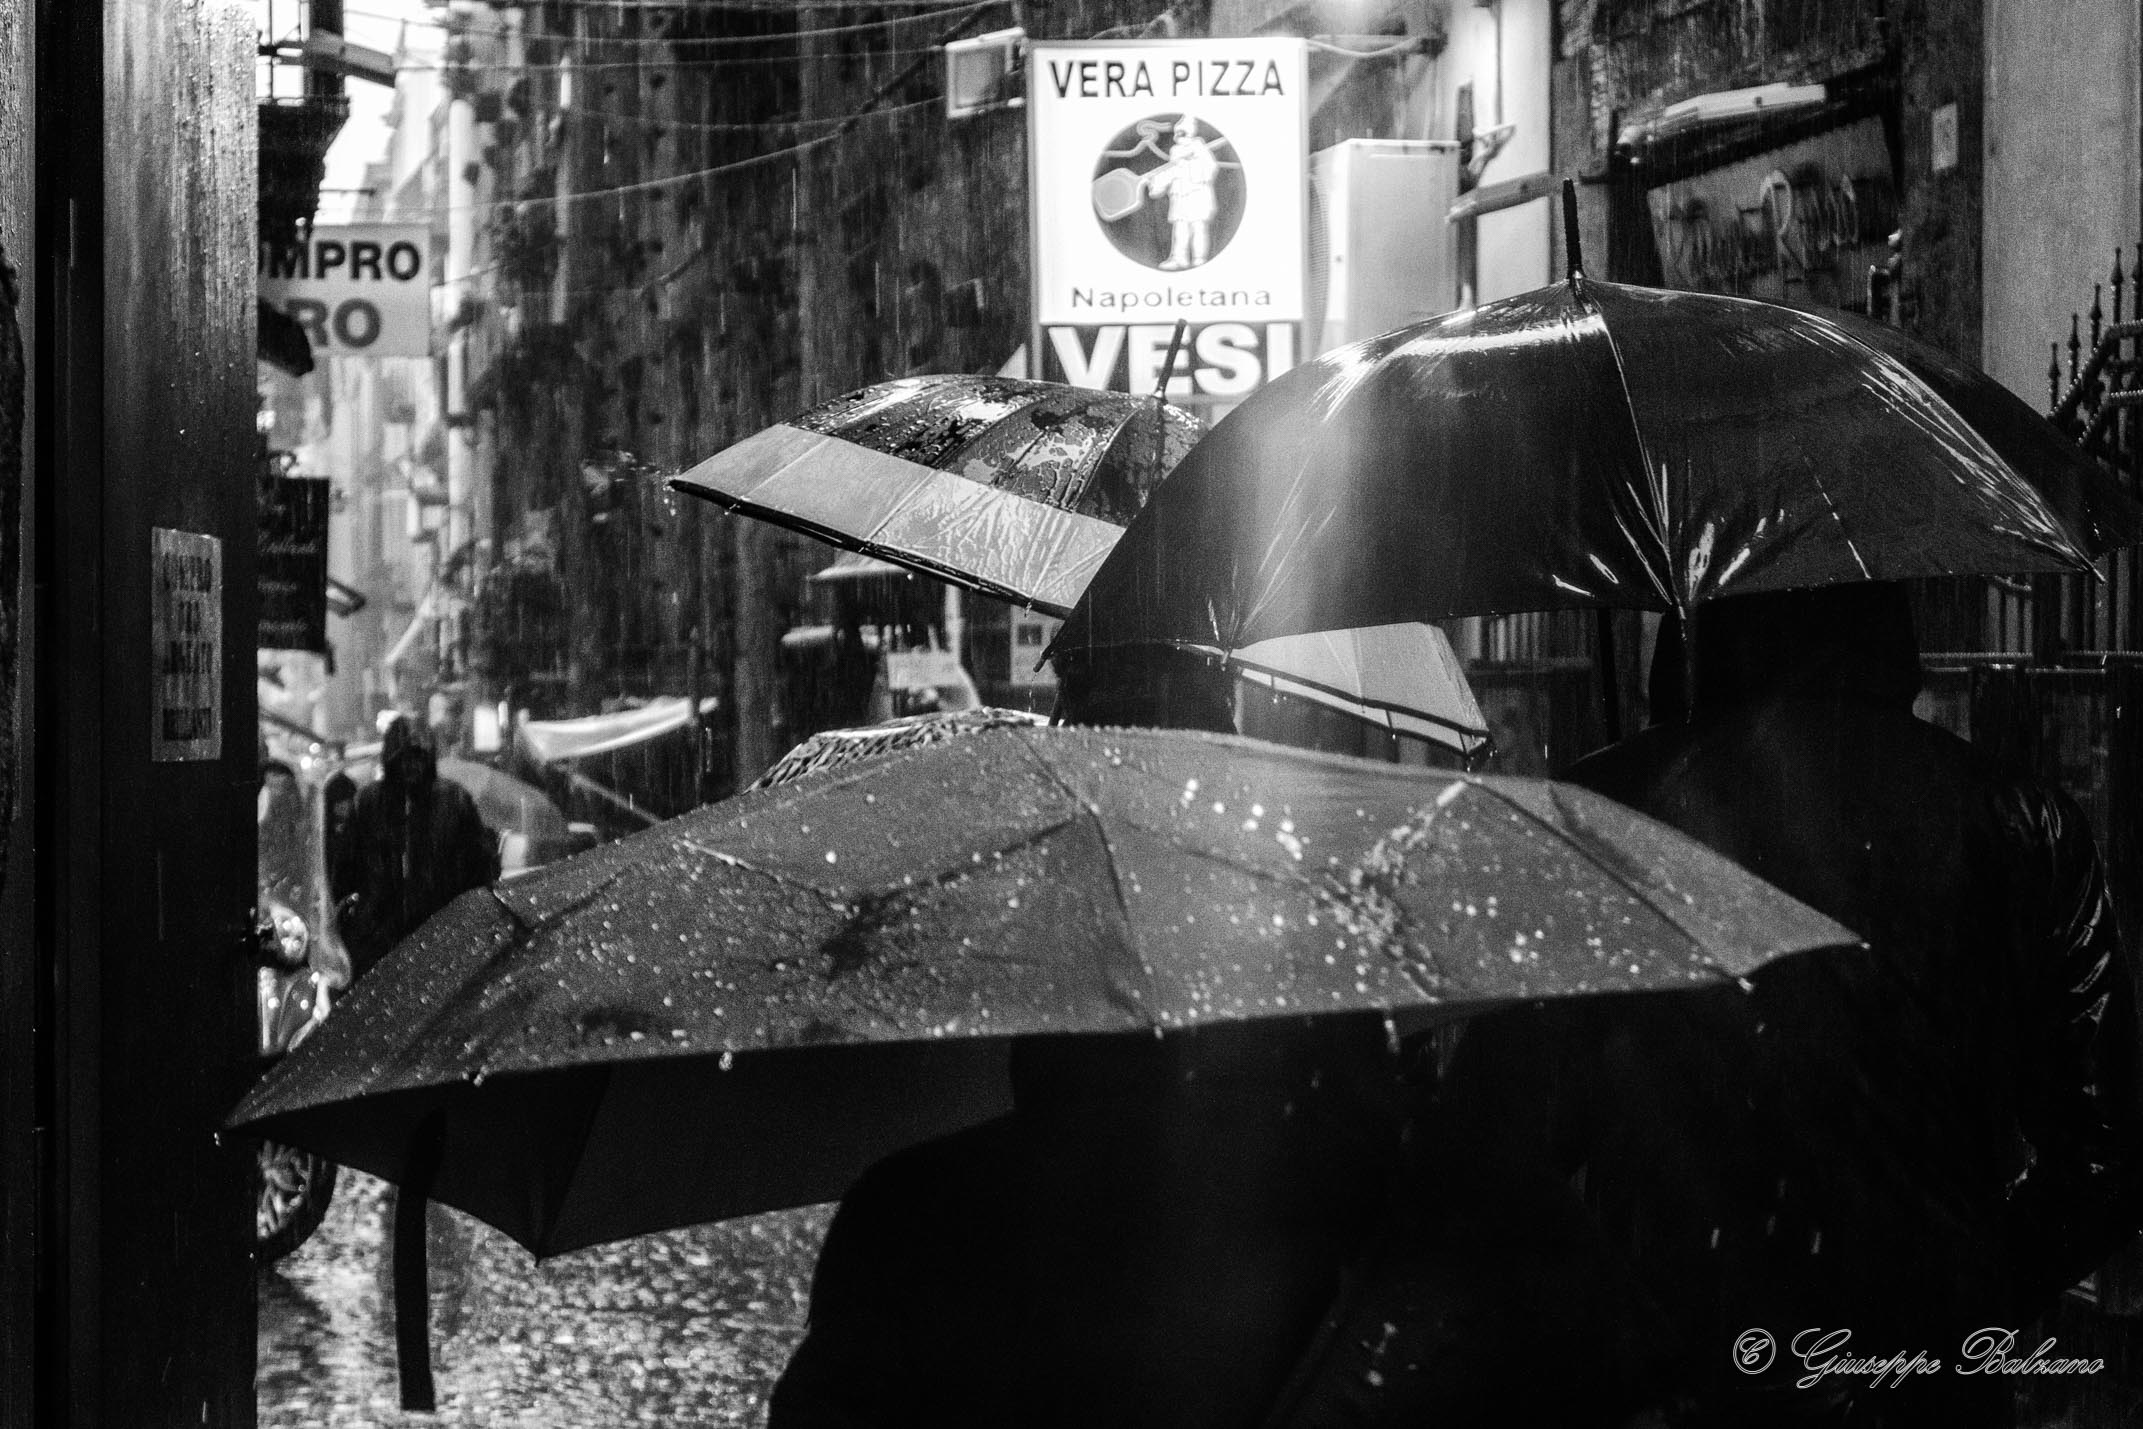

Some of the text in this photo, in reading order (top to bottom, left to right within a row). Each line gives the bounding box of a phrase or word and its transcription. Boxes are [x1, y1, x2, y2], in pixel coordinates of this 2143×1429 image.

[1048, 59, 1285, 98] VERA PIZZA
[258, 240, 420, 281] MPRO
[1071, 287, 1272, 312] Napoletana
